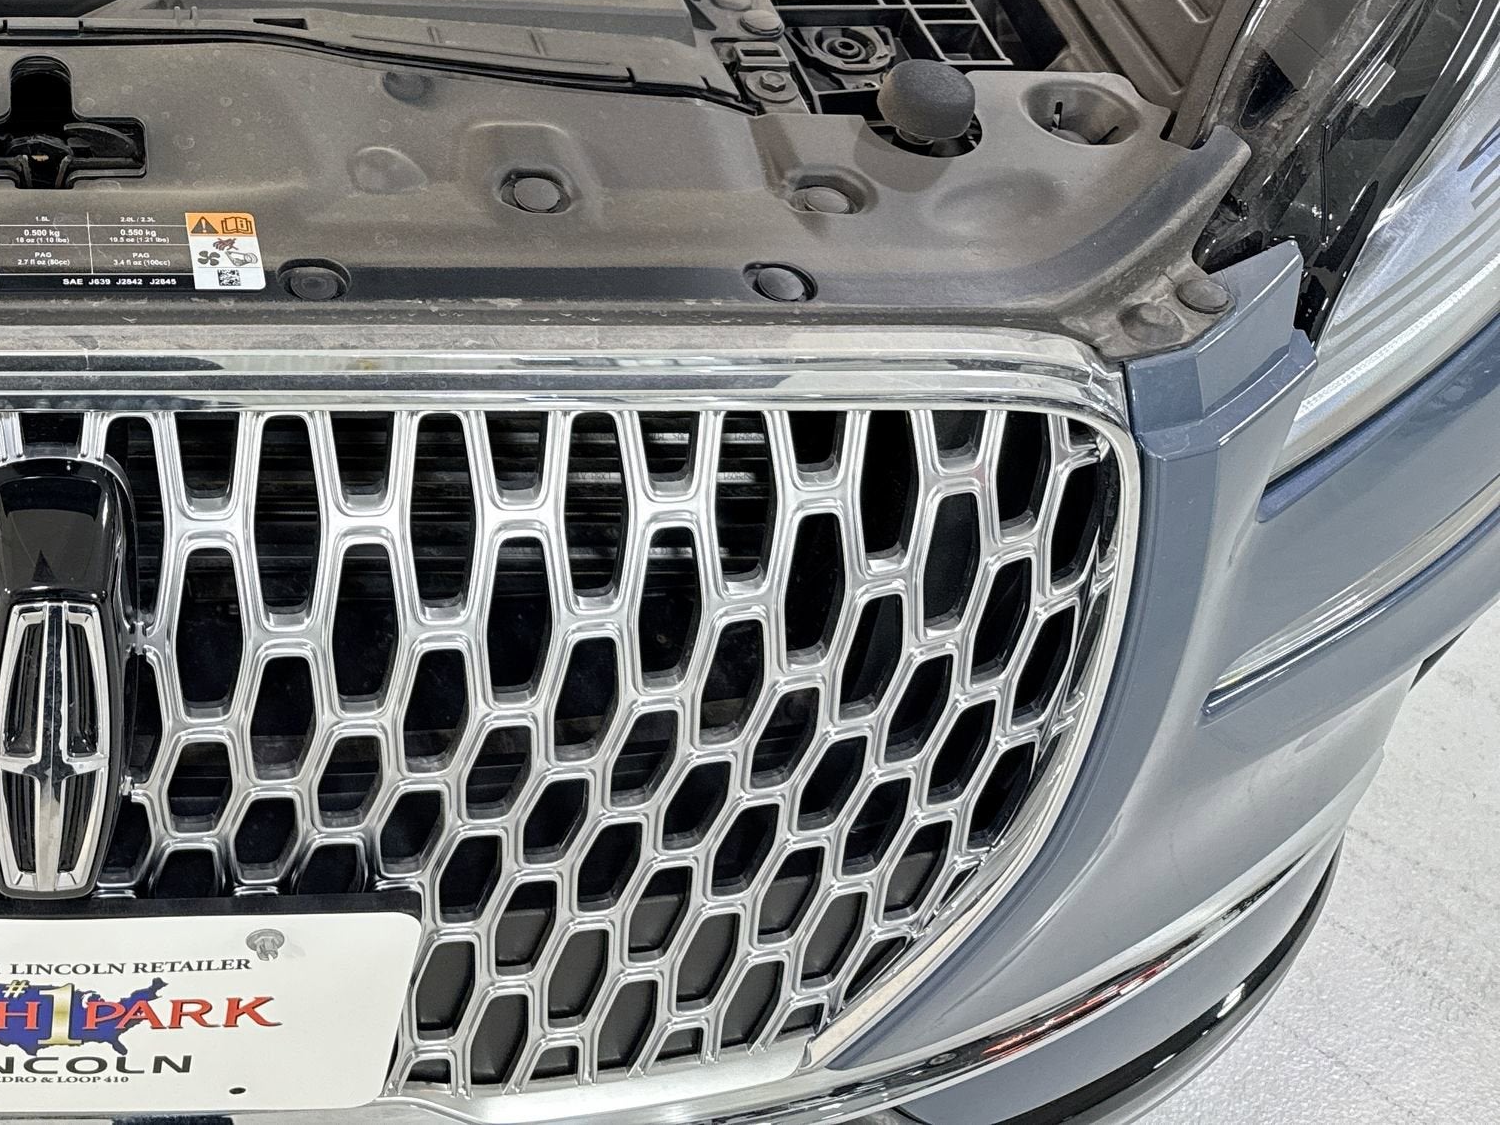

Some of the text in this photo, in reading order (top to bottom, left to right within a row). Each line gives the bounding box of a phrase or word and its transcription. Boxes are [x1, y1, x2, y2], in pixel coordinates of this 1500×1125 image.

[49, 229, 60, 237] kg
[145, 229, 156, 237] kg
[10, 963, 125, 975] LINCOLN
[132, 958, 252, 974] RETAILER
[82, 996, 283, 1030] PARK
[57, 1075, 101, 1083] LOOP
[104, 1075, 129, 1083] 410
